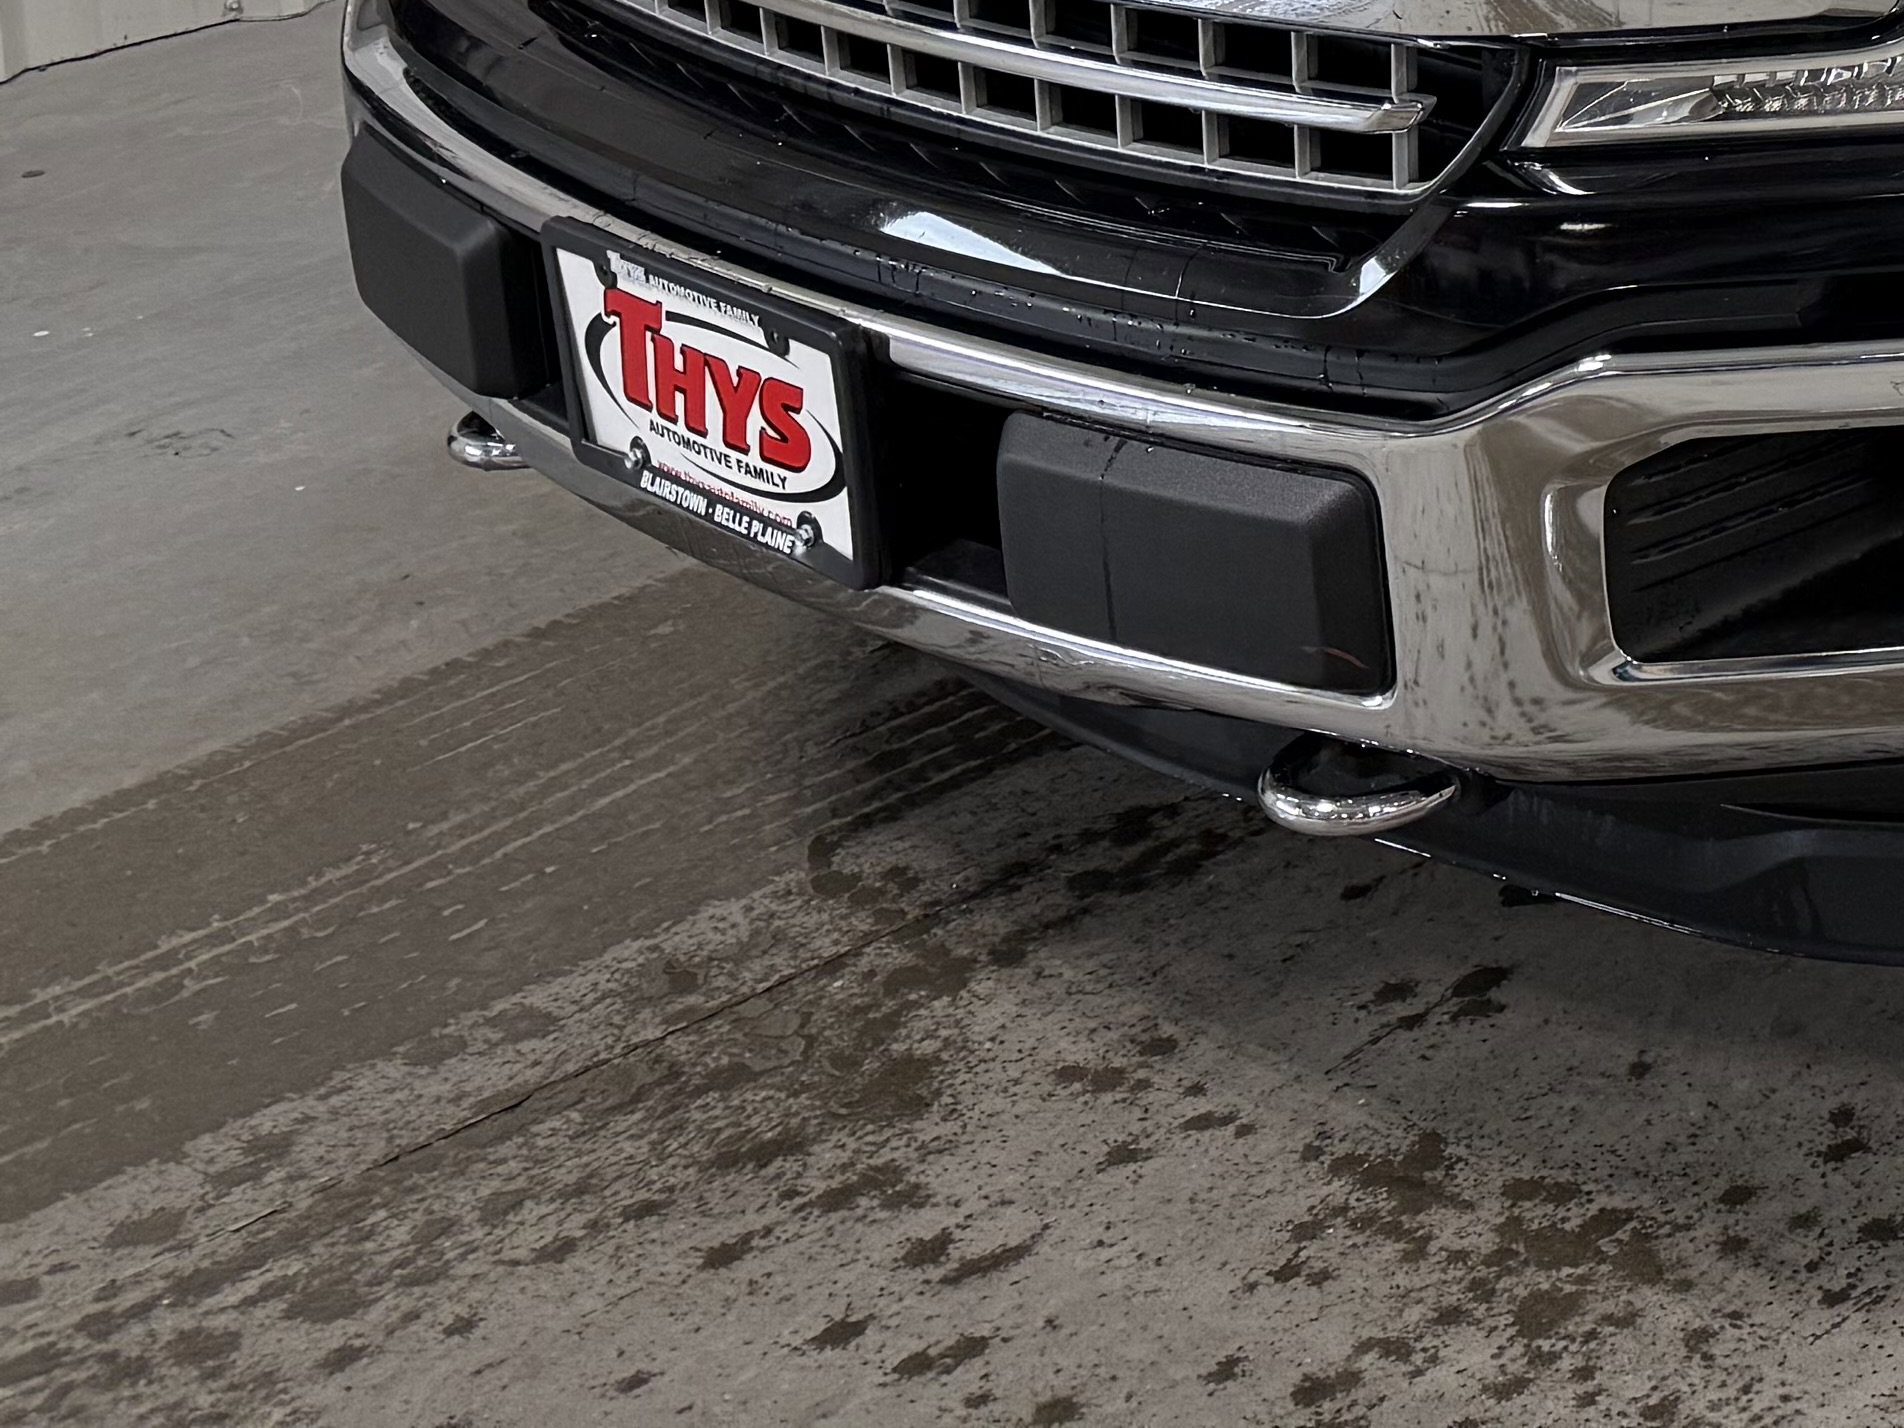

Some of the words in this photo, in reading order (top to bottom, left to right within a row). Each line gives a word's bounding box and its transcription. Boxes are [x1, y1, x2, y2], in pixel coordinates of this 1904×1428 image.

[649, 275, 718, 309] AUTOMOTIVE
[720, 301, 760, 327] FAMILY
[603, 288, 811, 473] THYS
[650, 420, 732, 468] AUTOMOTIVE
[735, 459, 787, 490] FAMILY
[640, 470, 708, 516] BLAIRSTOWN
[714, 504, 749, 534] BELLE
[749, 520, 795, 554] PLAINE
